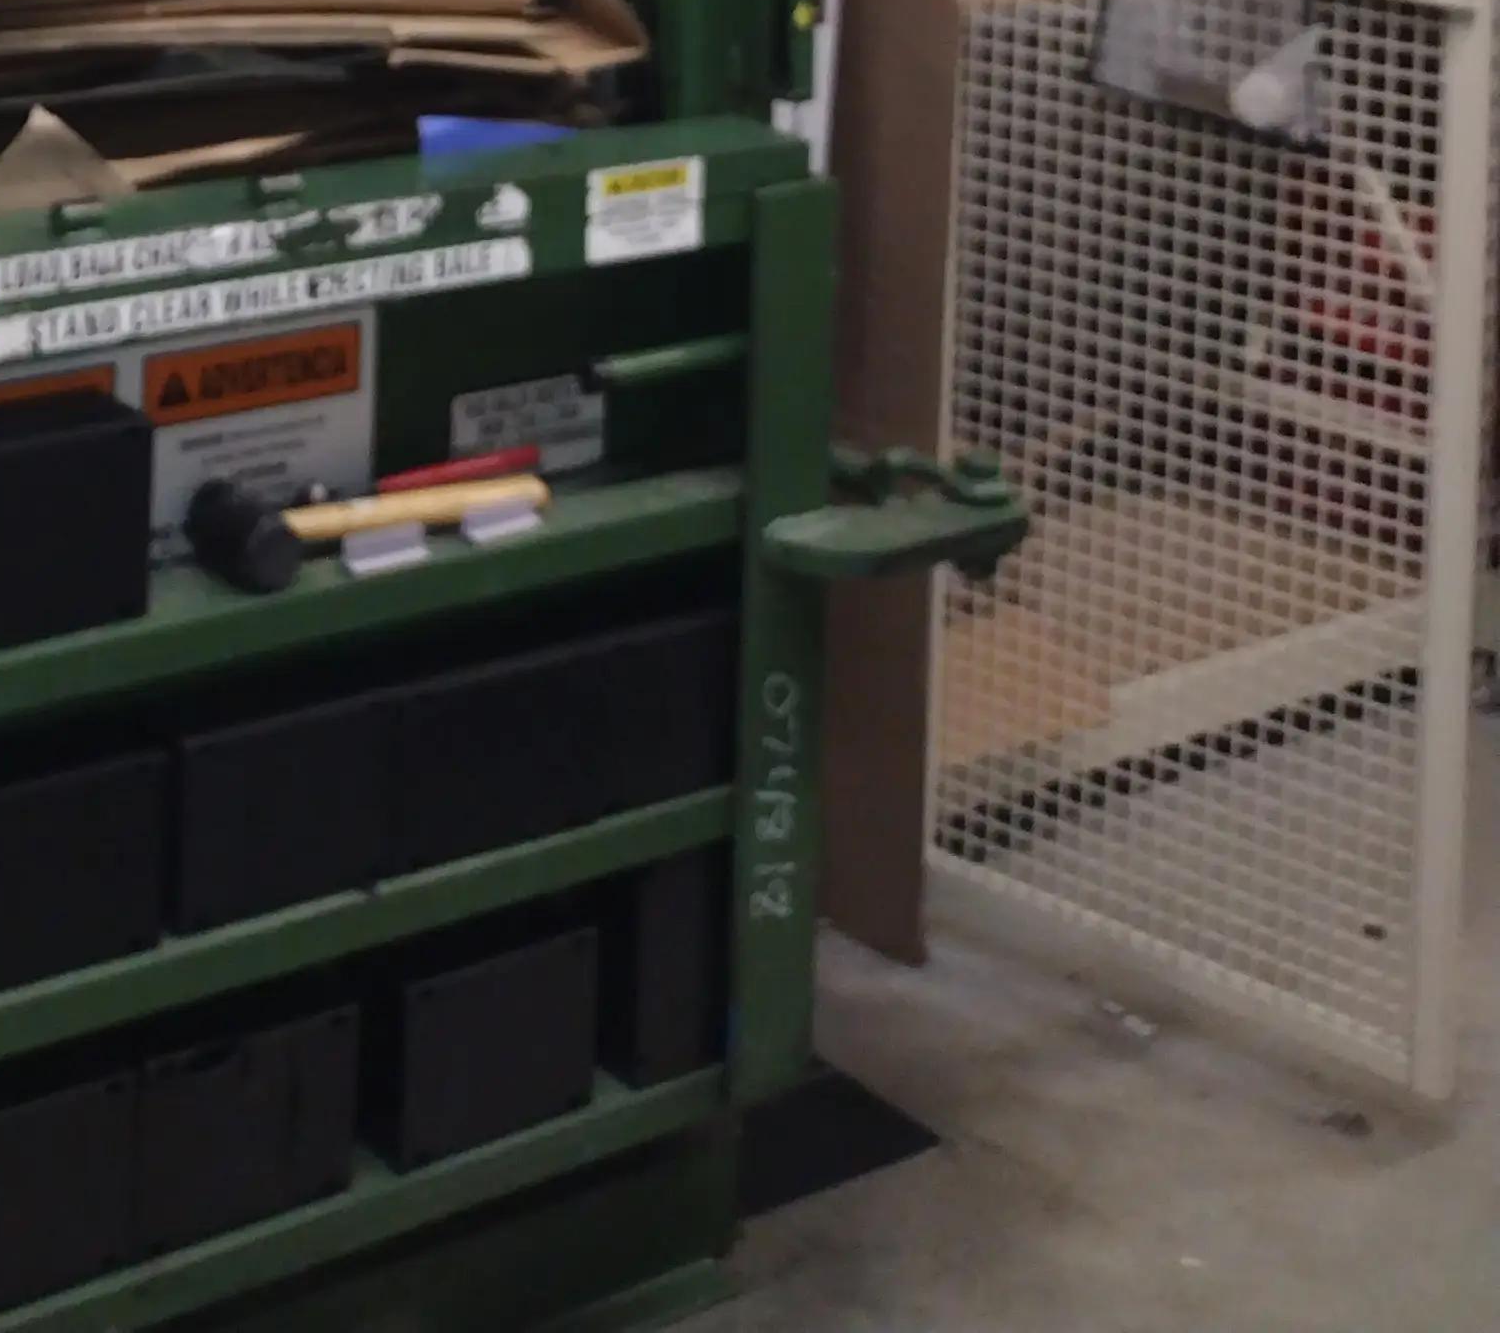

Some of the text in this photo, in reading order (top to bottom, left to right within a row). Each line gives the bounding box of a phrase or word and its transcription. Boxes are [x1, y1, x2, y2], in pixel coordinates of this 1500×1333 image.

[29, 307, 126, 345] STAND
[130, 293, 212, 333] CLEAR
[223, 280, 299, 314] WHILE
[433, 242, 492, 274] BALE
